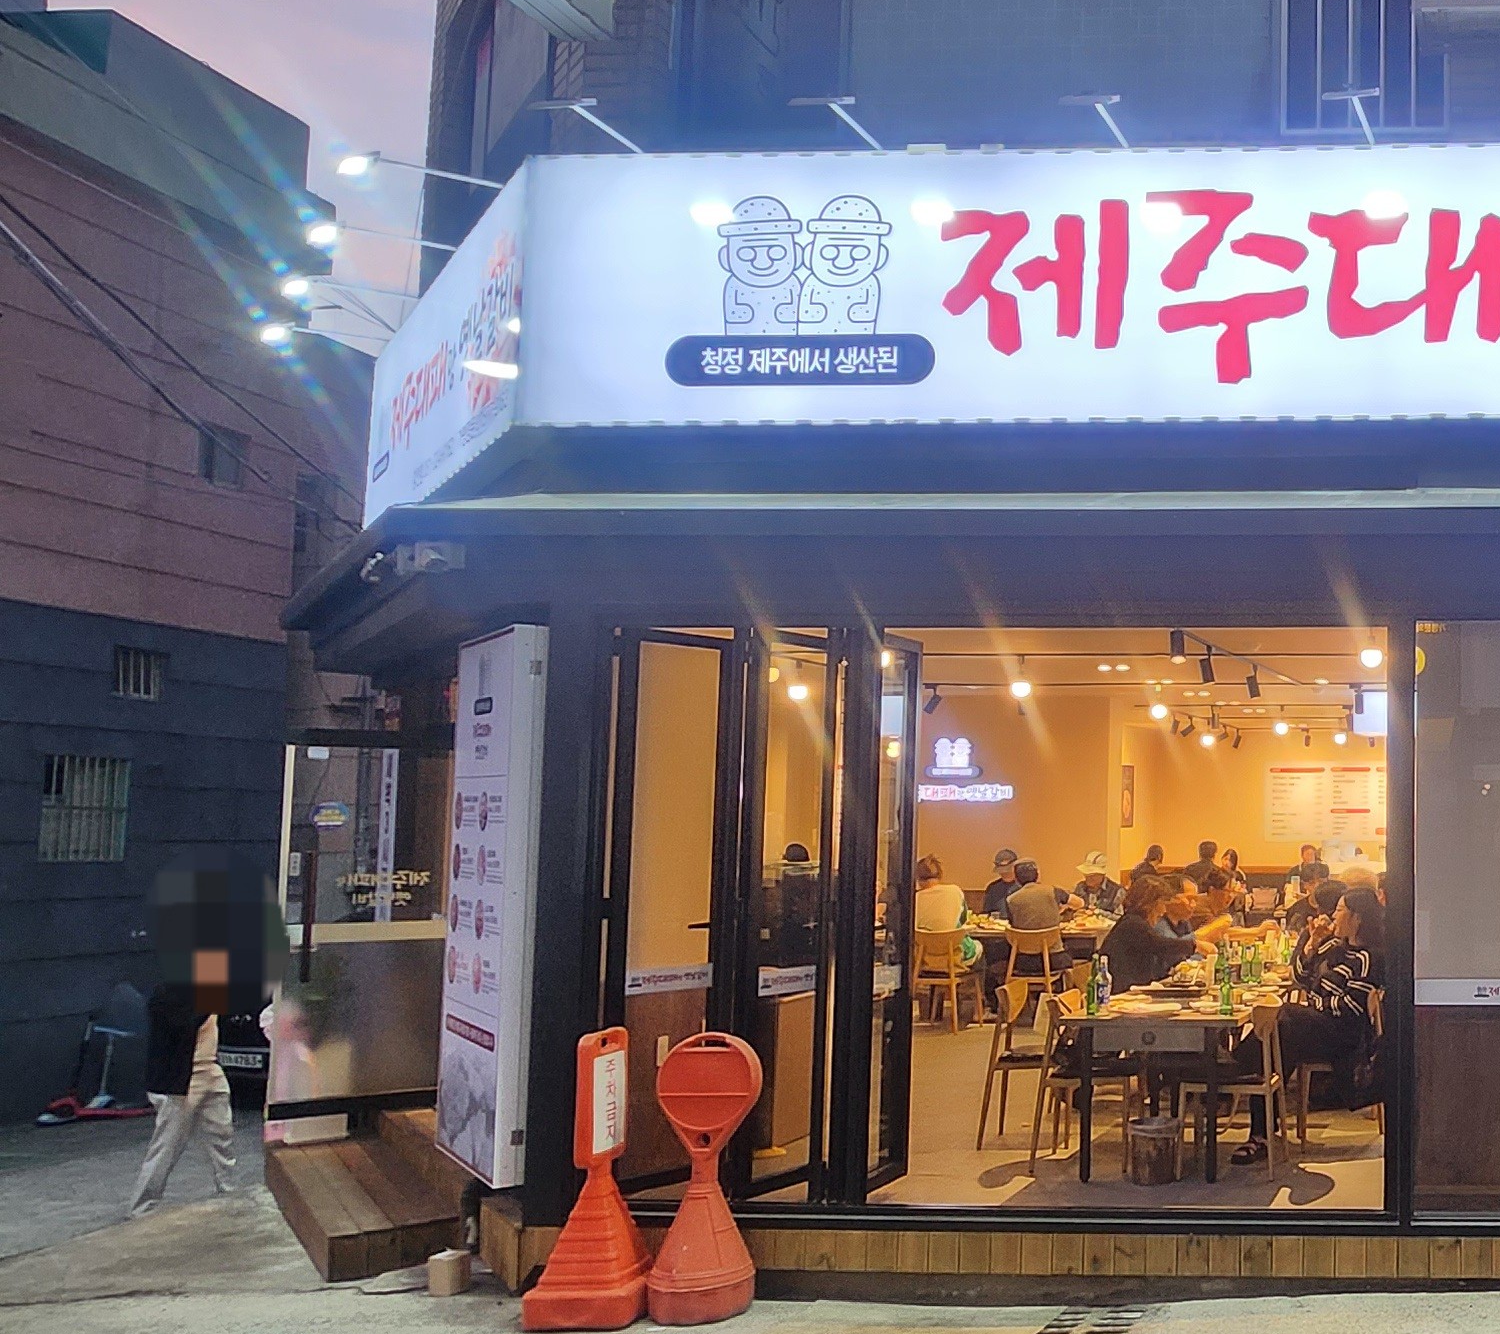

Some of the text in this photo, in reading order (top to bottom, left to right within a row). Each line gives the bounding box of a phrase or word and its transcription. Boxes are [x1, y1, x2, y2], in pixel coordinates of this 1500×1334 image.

[700, 345, 899, 375] 청정 제주에서 생산된
[605, 1058, 617, 1141] 주차금지
